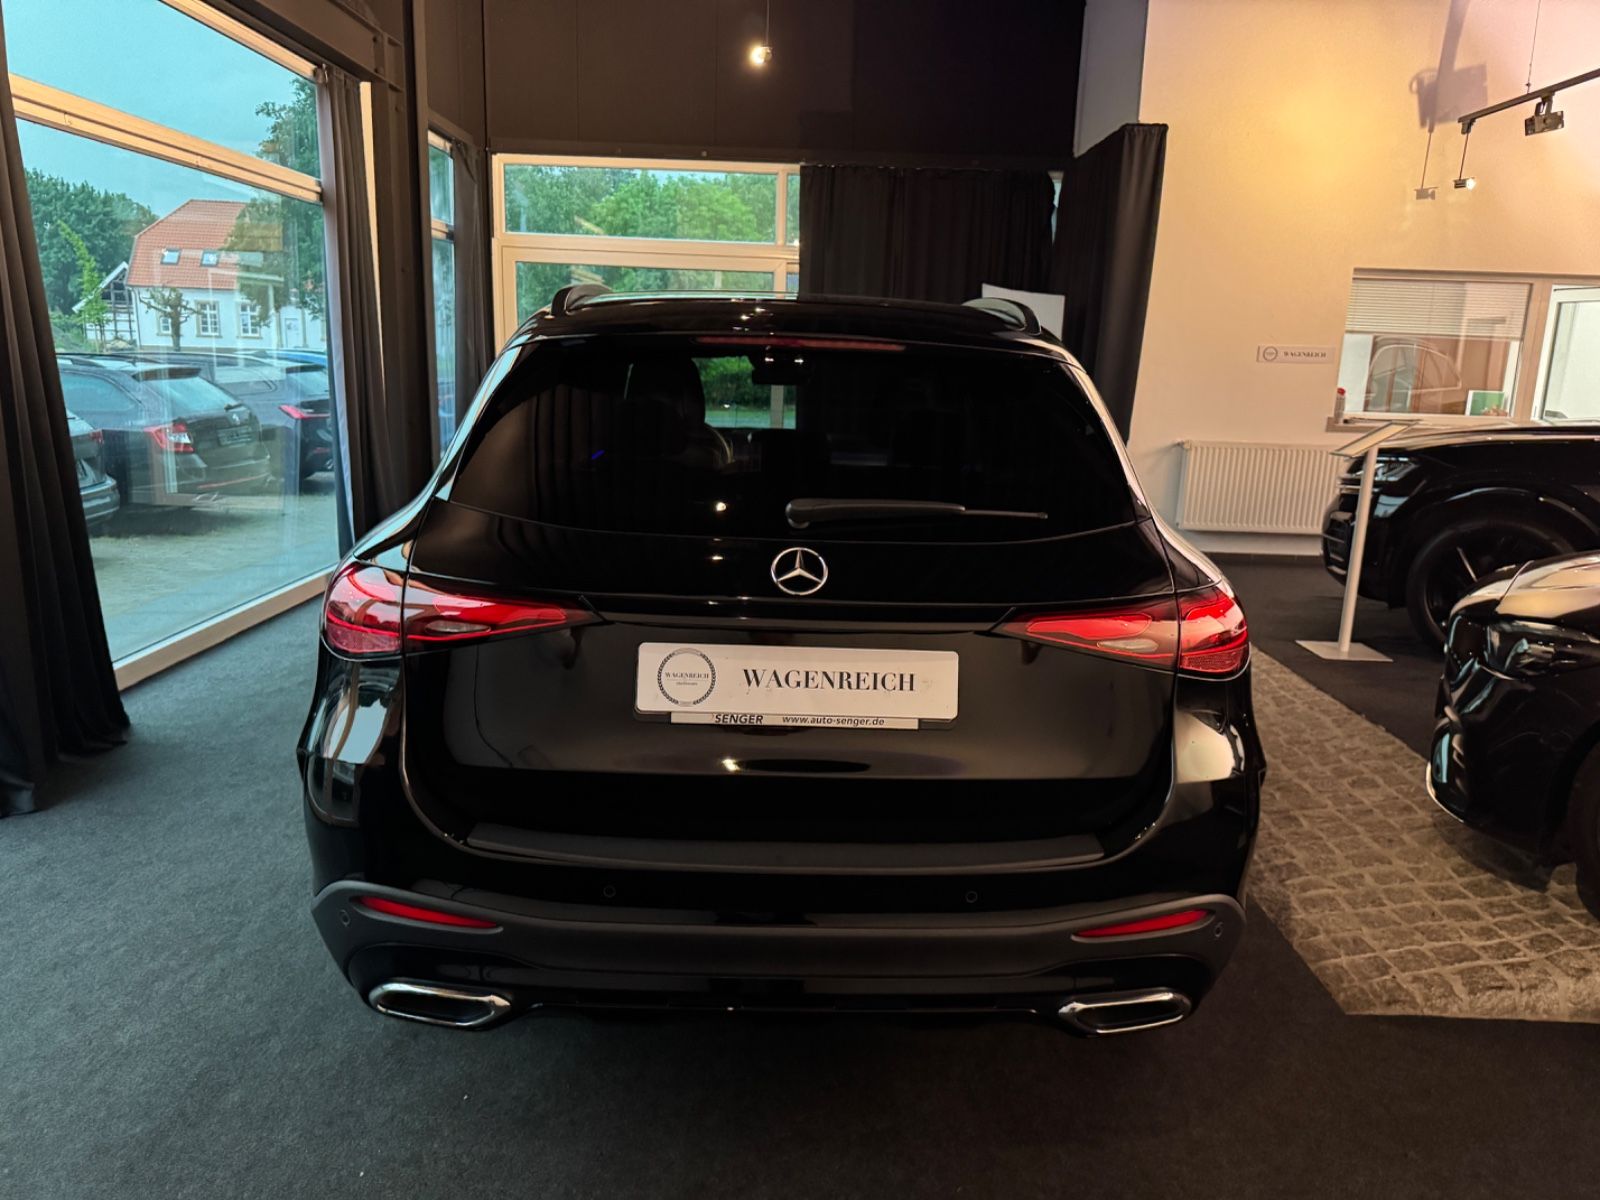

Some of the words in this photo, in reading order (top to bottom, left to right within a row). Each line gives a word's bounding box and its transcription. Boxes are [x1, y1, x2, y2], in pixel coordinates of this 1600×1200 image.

[742, 668, 915, 691] WAGENREICH
[714, 714, 764, 725] SENGER
[782, 715, 885, 727] www.auto-senger.de
